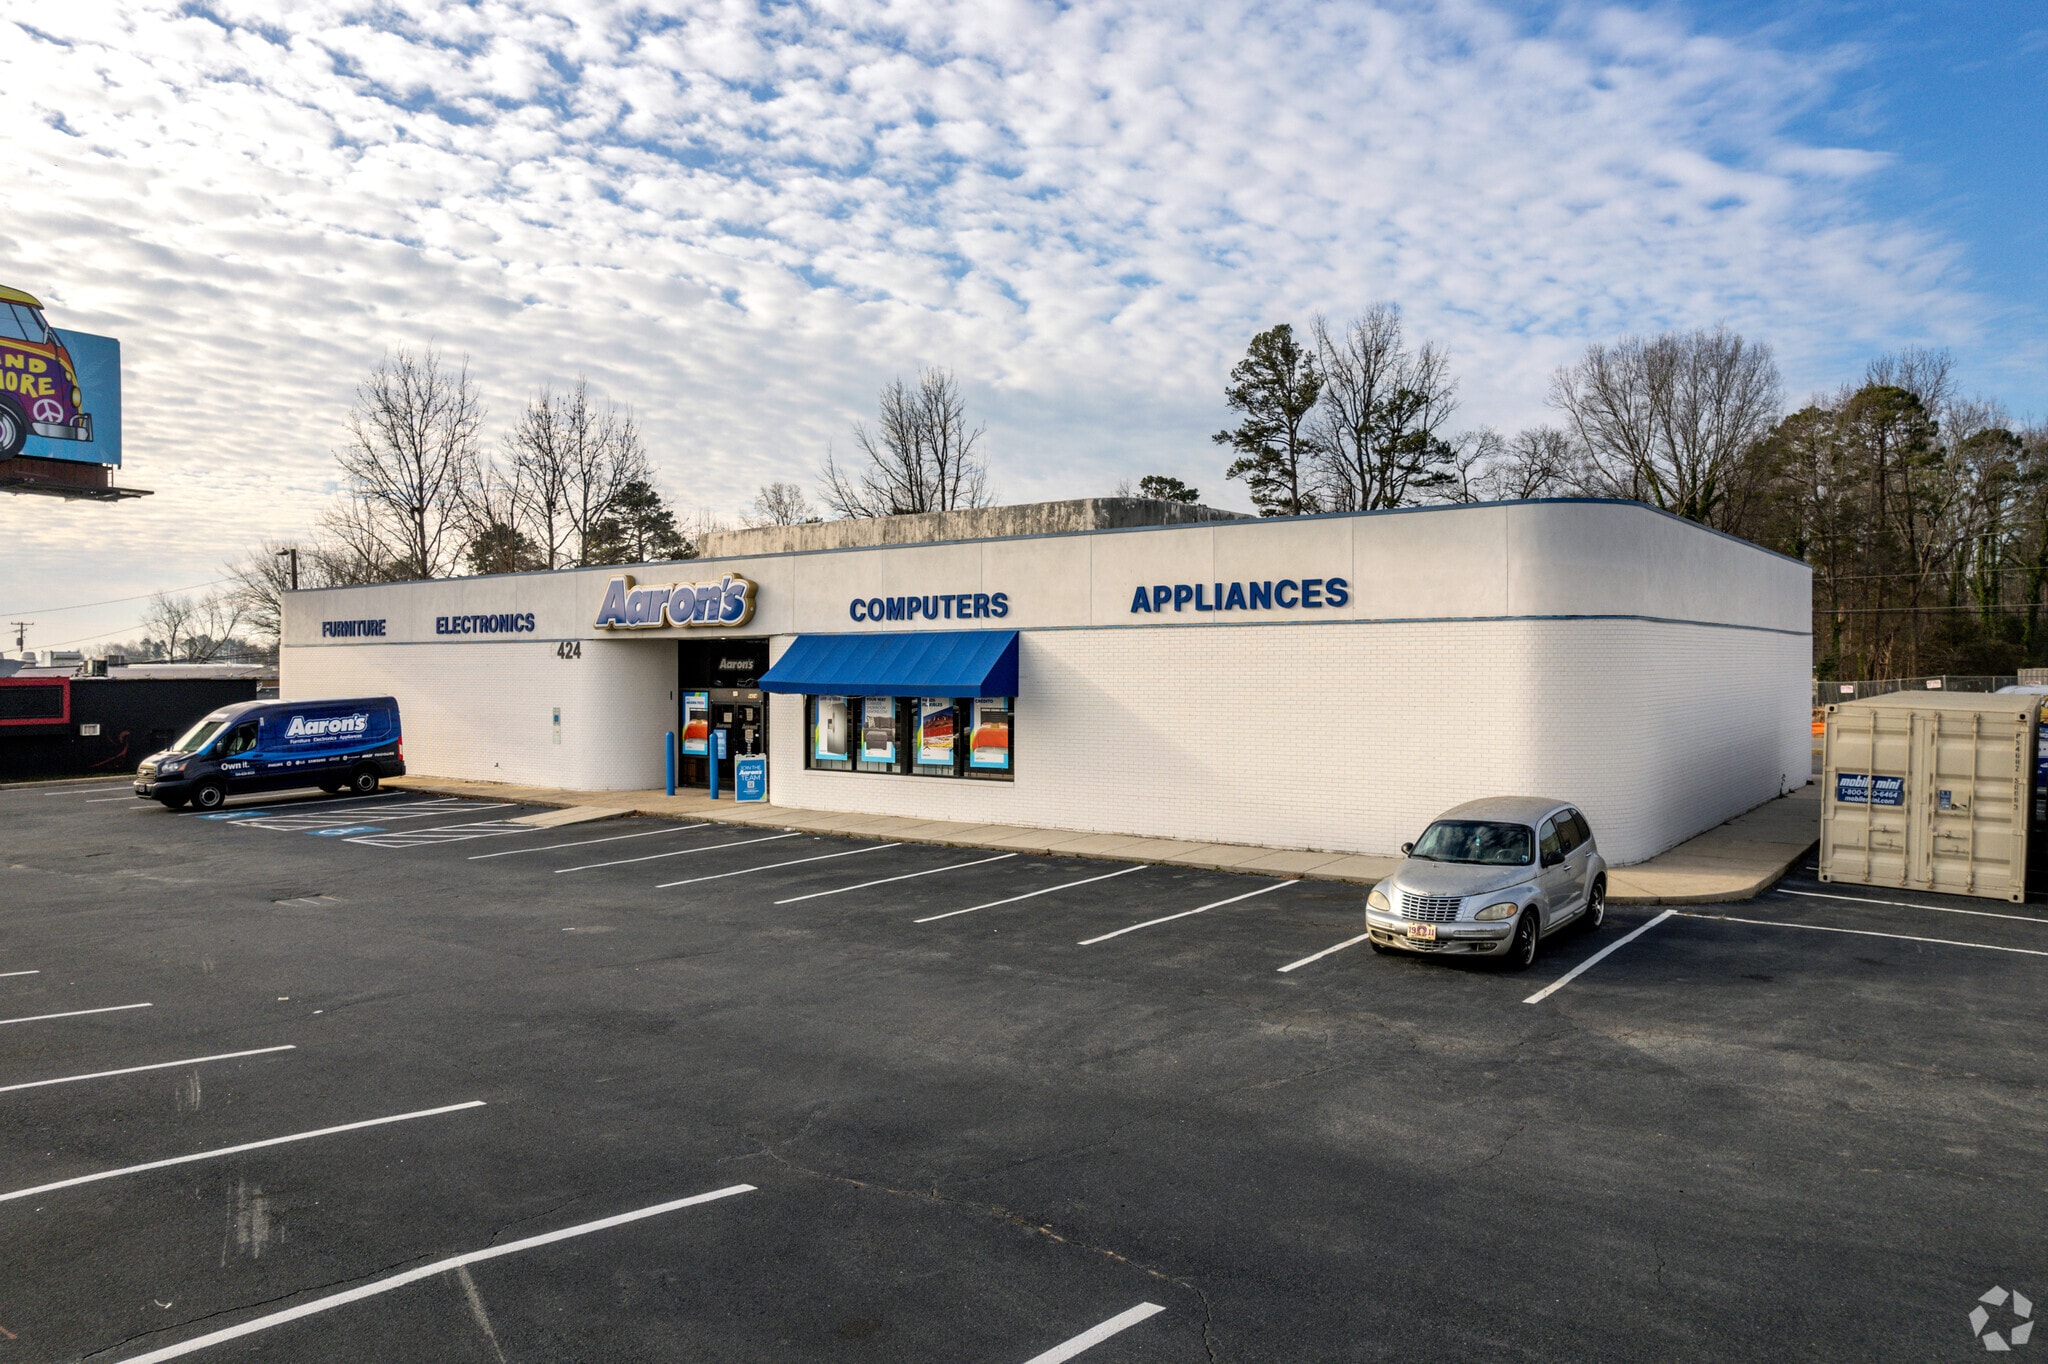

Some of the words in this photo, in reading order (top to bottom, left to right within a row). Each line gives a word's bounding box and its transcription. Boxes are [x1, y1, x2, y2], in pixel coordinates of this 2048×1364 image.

[0, 354, 47, 373] ND
[594, 572, 757, 630] Aaron's
[1131, 577, 1349, 613] APPLIANCES
[850, 592, 1009, 622] COMPUTERS
[322, 619, 386, 637] FURNITURE
[436, 613, 535, 635] ELECTRONICS
[557, 642, 581, 659] 424
[719, 658, 754, 670] Aaron's
[285, 713, 368, 738] Aaron's
[339, 732, 362, 740] Appliances
[221, 762, 242, 771] Own
[242, 760, 250, 769] it.
[1841, 788, 1898, 798] 1-800-90-6464
[1875, 779, 1902, 790] mini
[1844, 795, 1895, 805] mobileini.com
